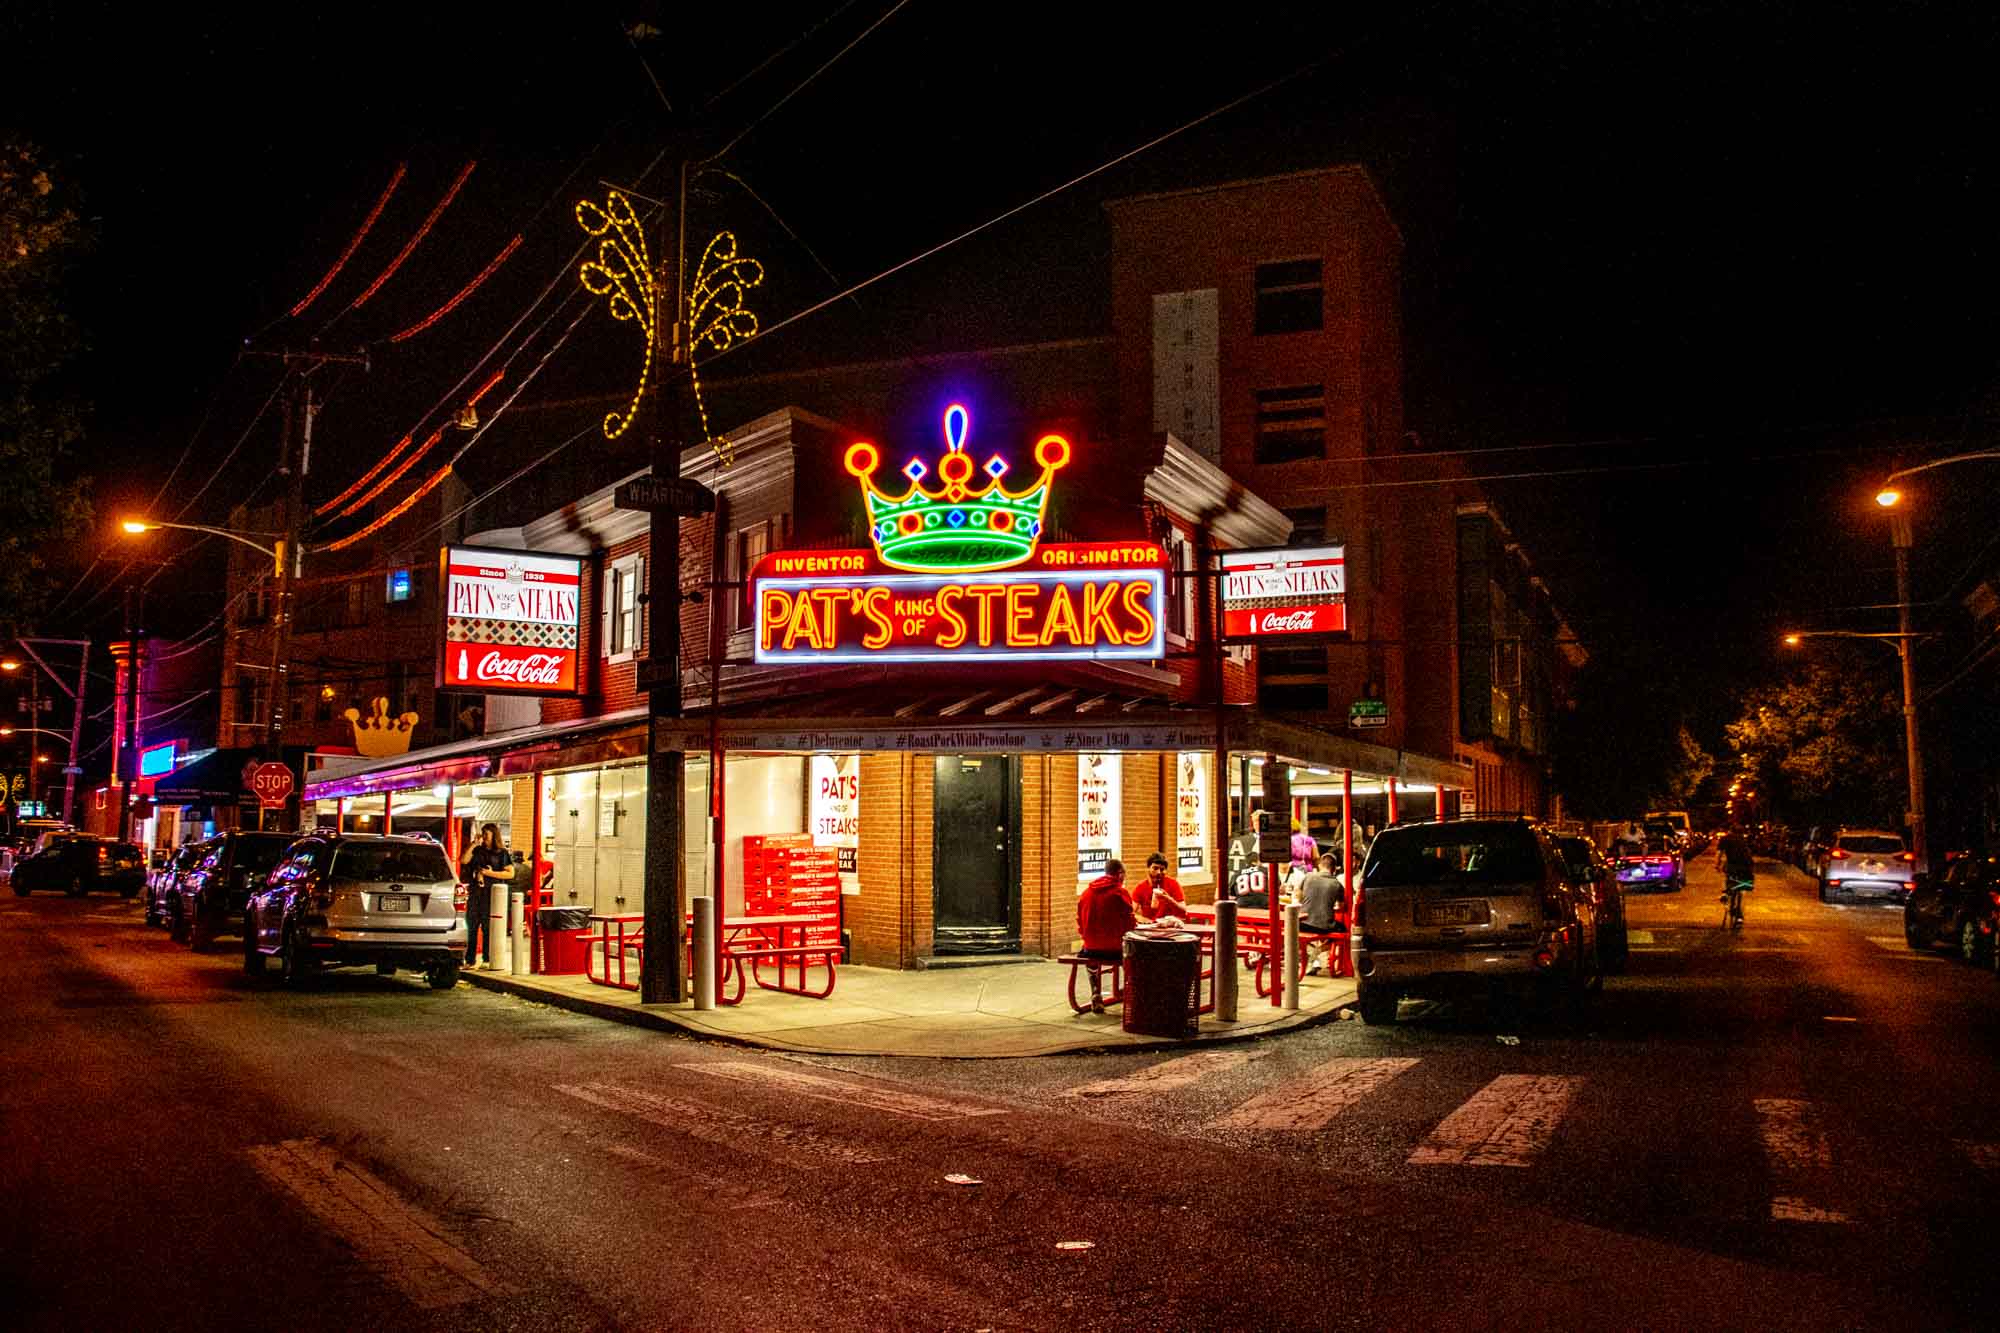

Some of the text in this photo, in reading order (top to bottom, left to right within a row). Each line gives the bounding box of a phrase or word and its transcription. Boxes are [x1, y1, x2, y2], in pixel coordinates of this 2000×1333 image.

[776, 557, 865, 572] INVENTOR
[1041, 547, 1159, 566] ORIGINATOR
[479, 569, 504, 578] Since
[1284, 569, 1339, 592] STEAKS
[1228, 575, 1265, 596] PAT'S
[453, 581, 495, 615] PAT'S
[496, 592, 516, 602] KING
[500, 602, 511, 610] OF
[516, 587, 575, 622] STEAKS
[895, 599, 936, 617] KING
[935, 582, 1155, 649] STEAKS
[760, 585, 894, 651] PAT'S
[903, 619, 926, 637] OF
[798, 734, 865, 748] #TheInventor
[256, 775, 290, 788] STOP
[821, 775, 857, 800] PAT'S
[819, 818, 858, 835] STEAKS
[1081, 820, 1109, 838] STEAKS
[1241, 866, 1260, 876] RICE
[1236, 872, 1267, 896] 80
